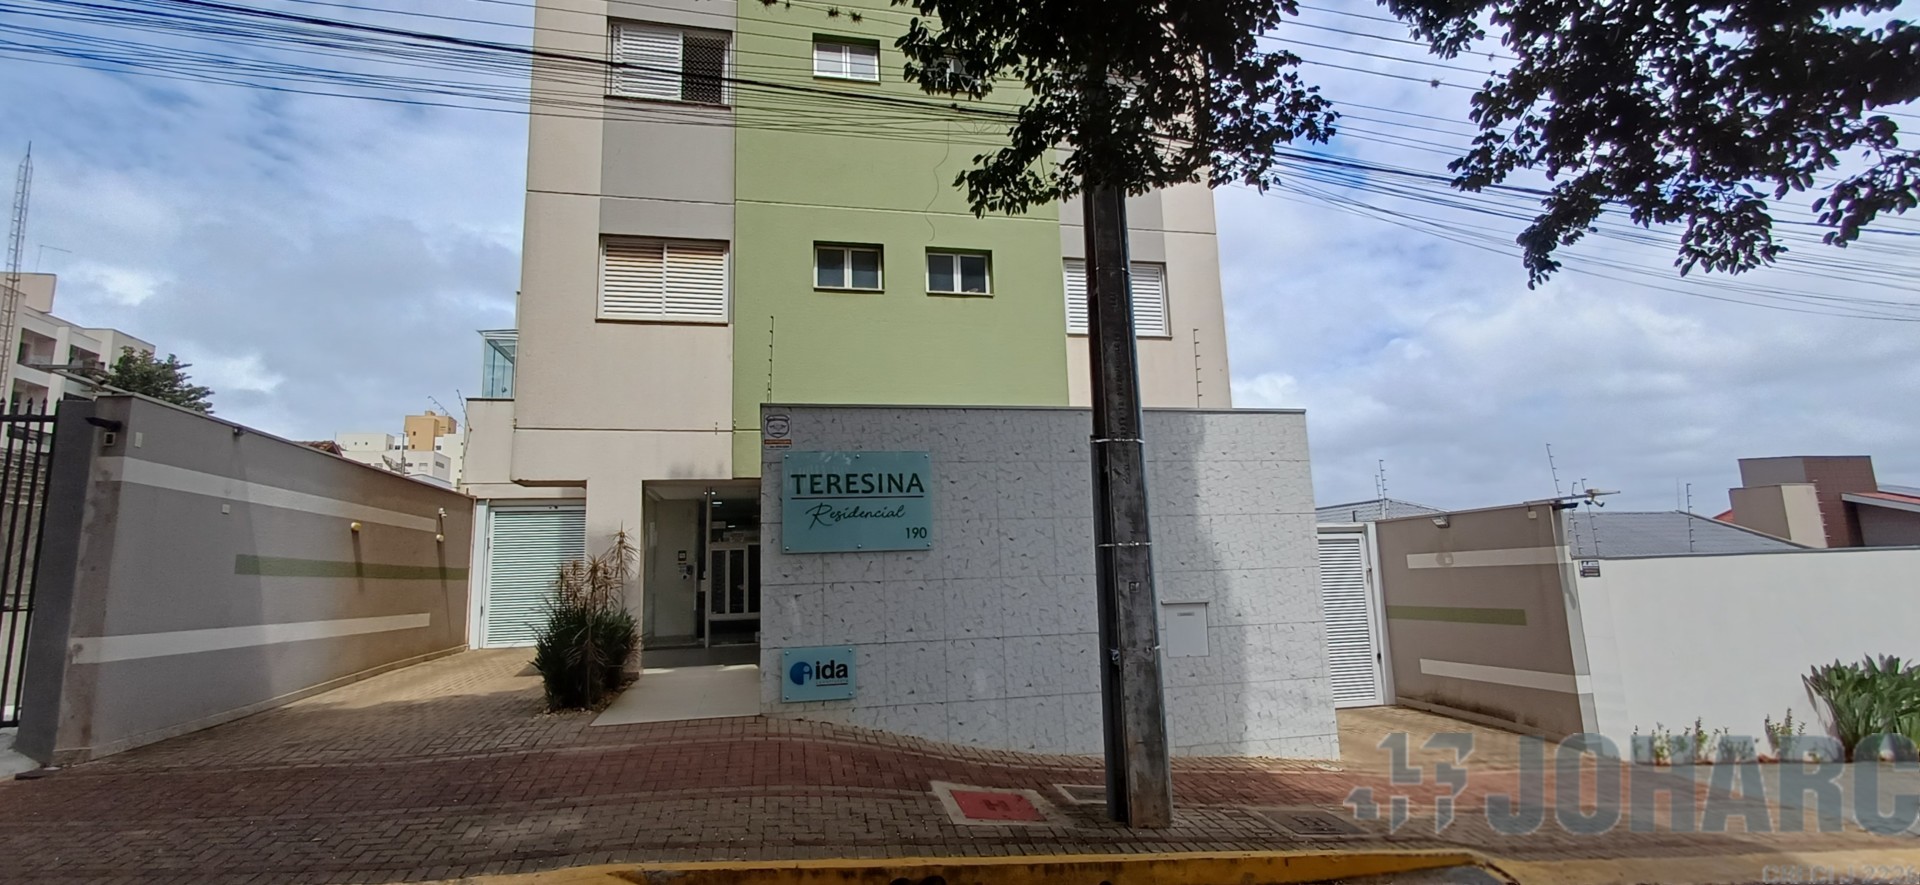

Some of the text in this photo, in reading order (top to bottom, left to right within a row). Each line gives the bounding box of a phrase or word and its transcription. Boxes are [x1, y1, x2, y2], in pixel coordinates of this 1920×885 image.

[790, 473, 925, 495] TERESINA
[805, 502, 905, 530] Residencial
[905, 526, 928, 539] 190
